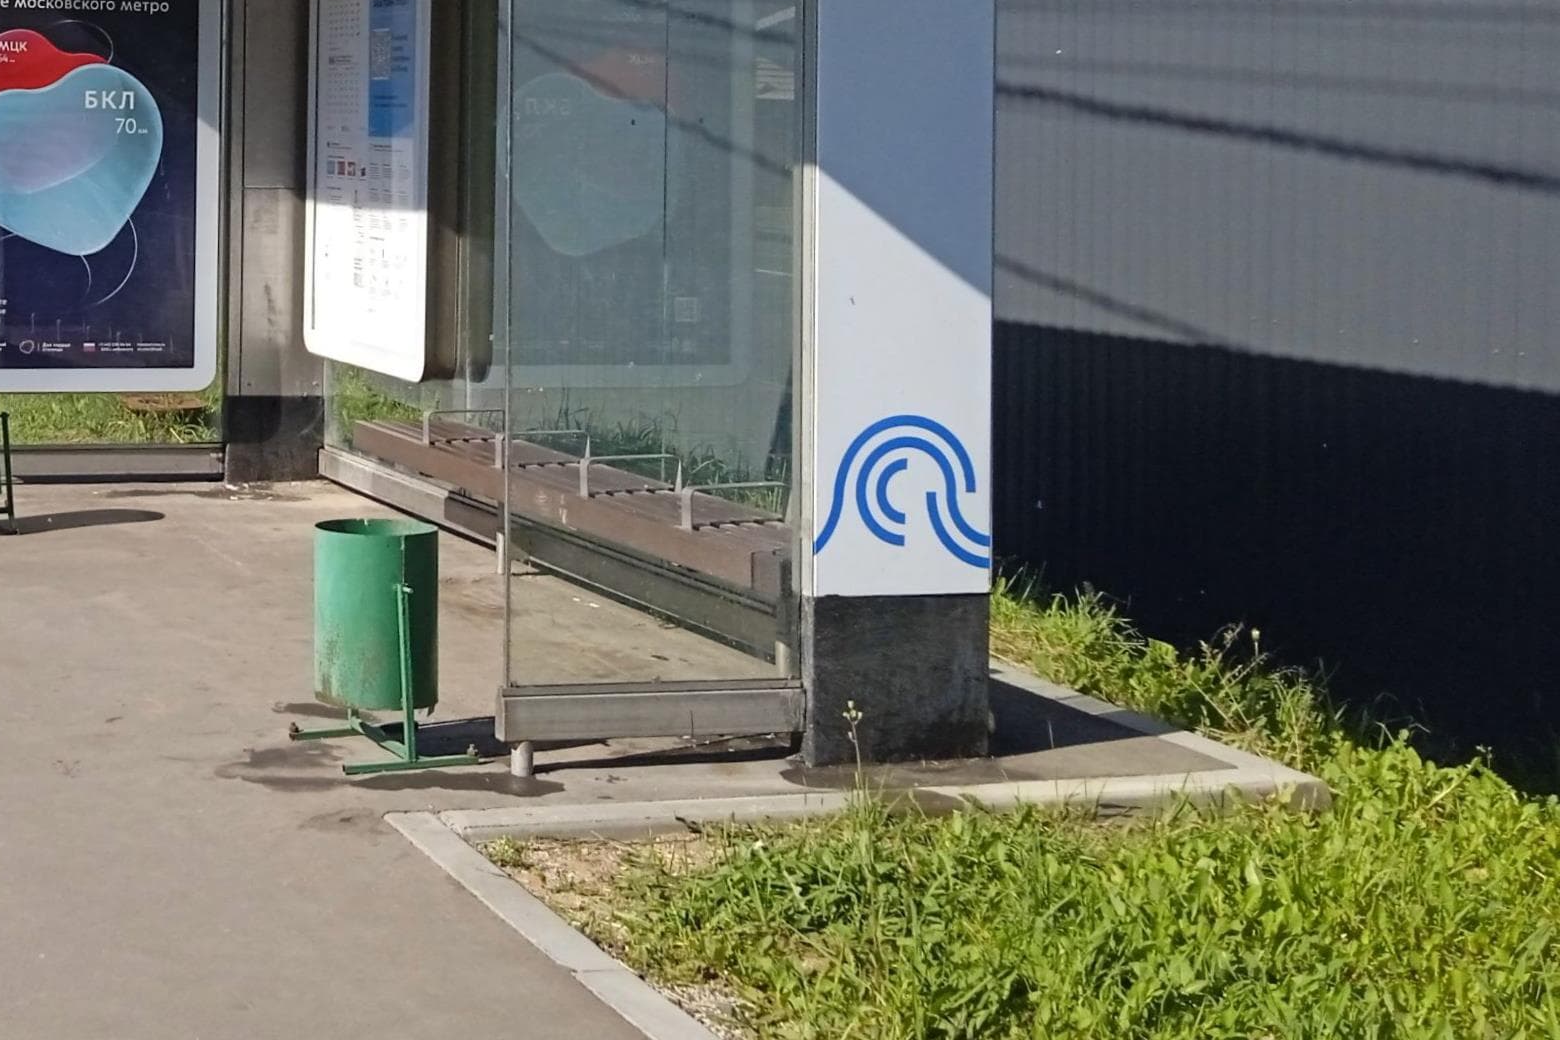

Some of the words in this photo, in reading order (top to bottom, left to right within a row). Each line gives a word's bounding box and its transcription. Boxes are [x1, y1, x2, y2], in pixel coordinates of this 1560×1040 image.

[120, 0, 170, 14] метро
[85, 90, 135, 110] БКЛ
[115, 118, 137, 134] 70
